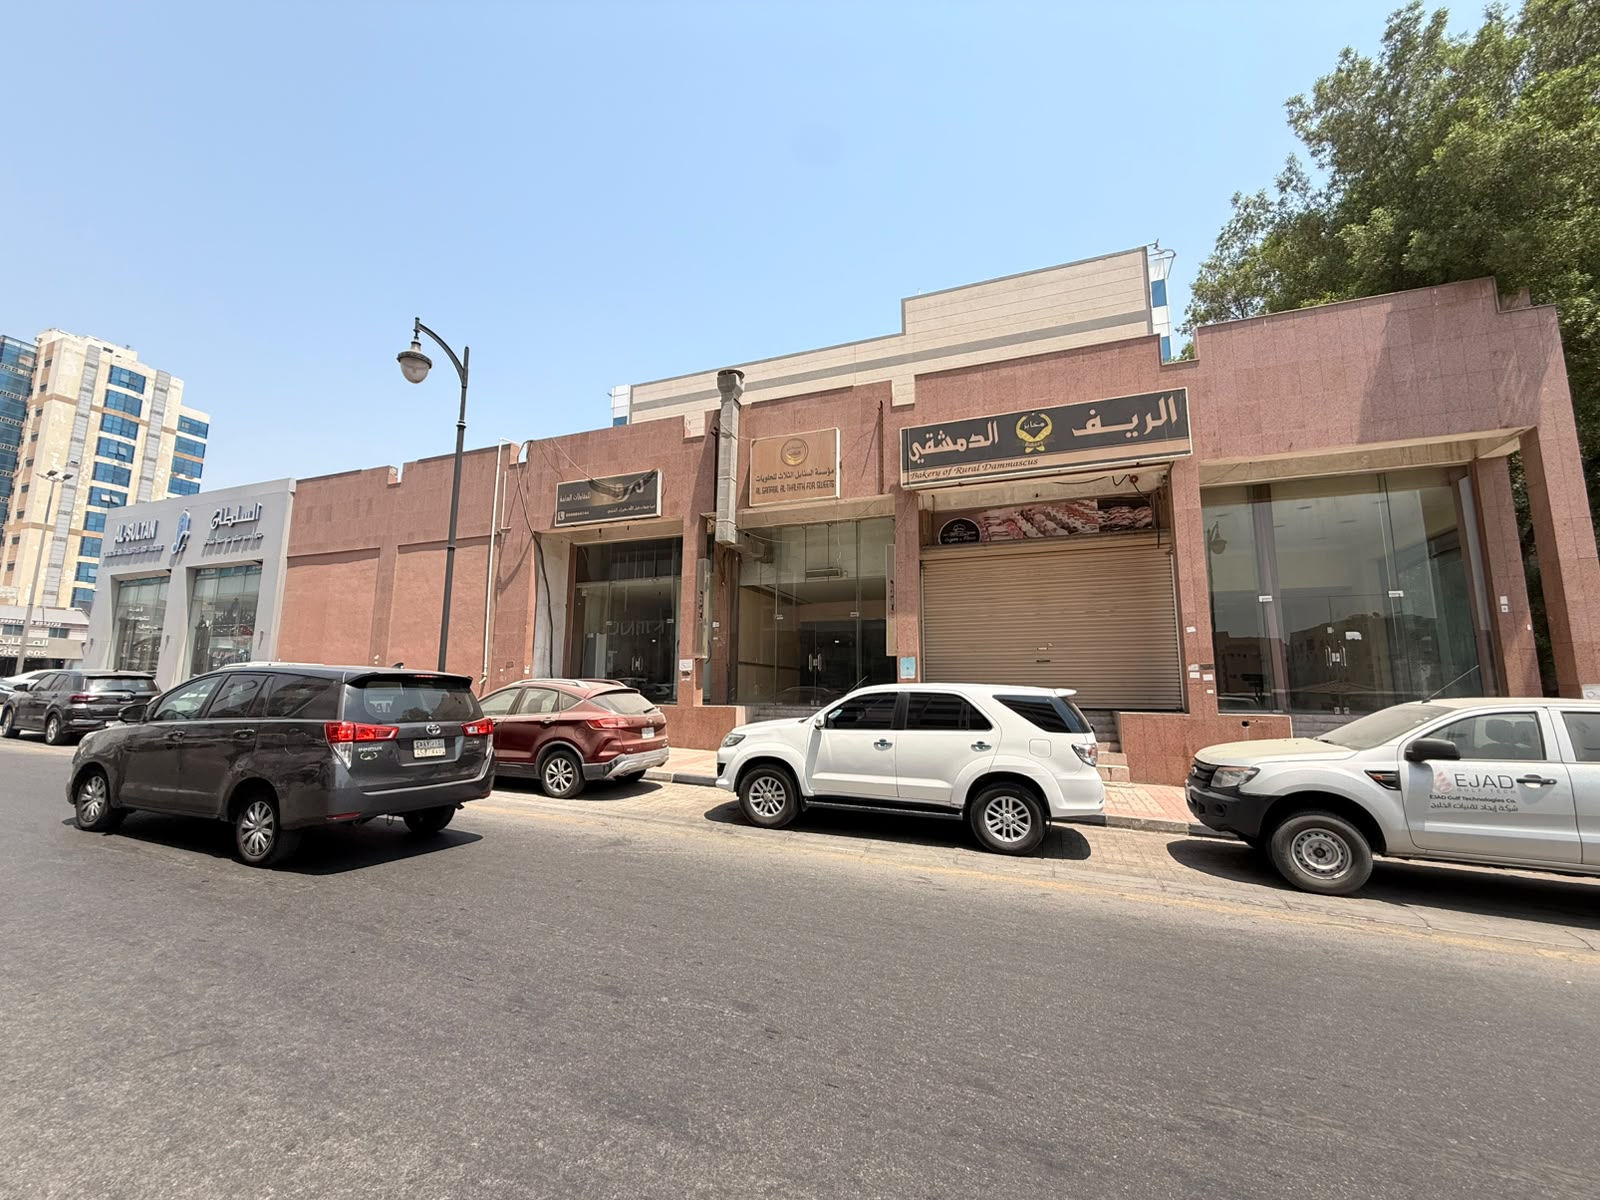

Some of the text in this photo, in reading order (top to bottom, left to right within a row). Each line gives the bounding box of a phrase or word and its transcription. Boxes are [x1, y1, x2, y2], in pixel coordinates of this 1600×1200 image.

[1072, 395, 1178, 438] الريف
[908, 420, 999, 464] الدمشقي
[815, 466, 834, 477] مؤسسة
[910, 458, 1039, 480] Bakery of Rural Dammascus
[806, 481, 816, 490] FOR
[816, 479, 834, 489] SWEETS
[114, 519, 157, 543] AL-SULTAN
[1454, 773, 1514, 789] EJAD
[1462, 795, 1505, 803] Technologies
[1498, 804, 1519, 812] شركة
